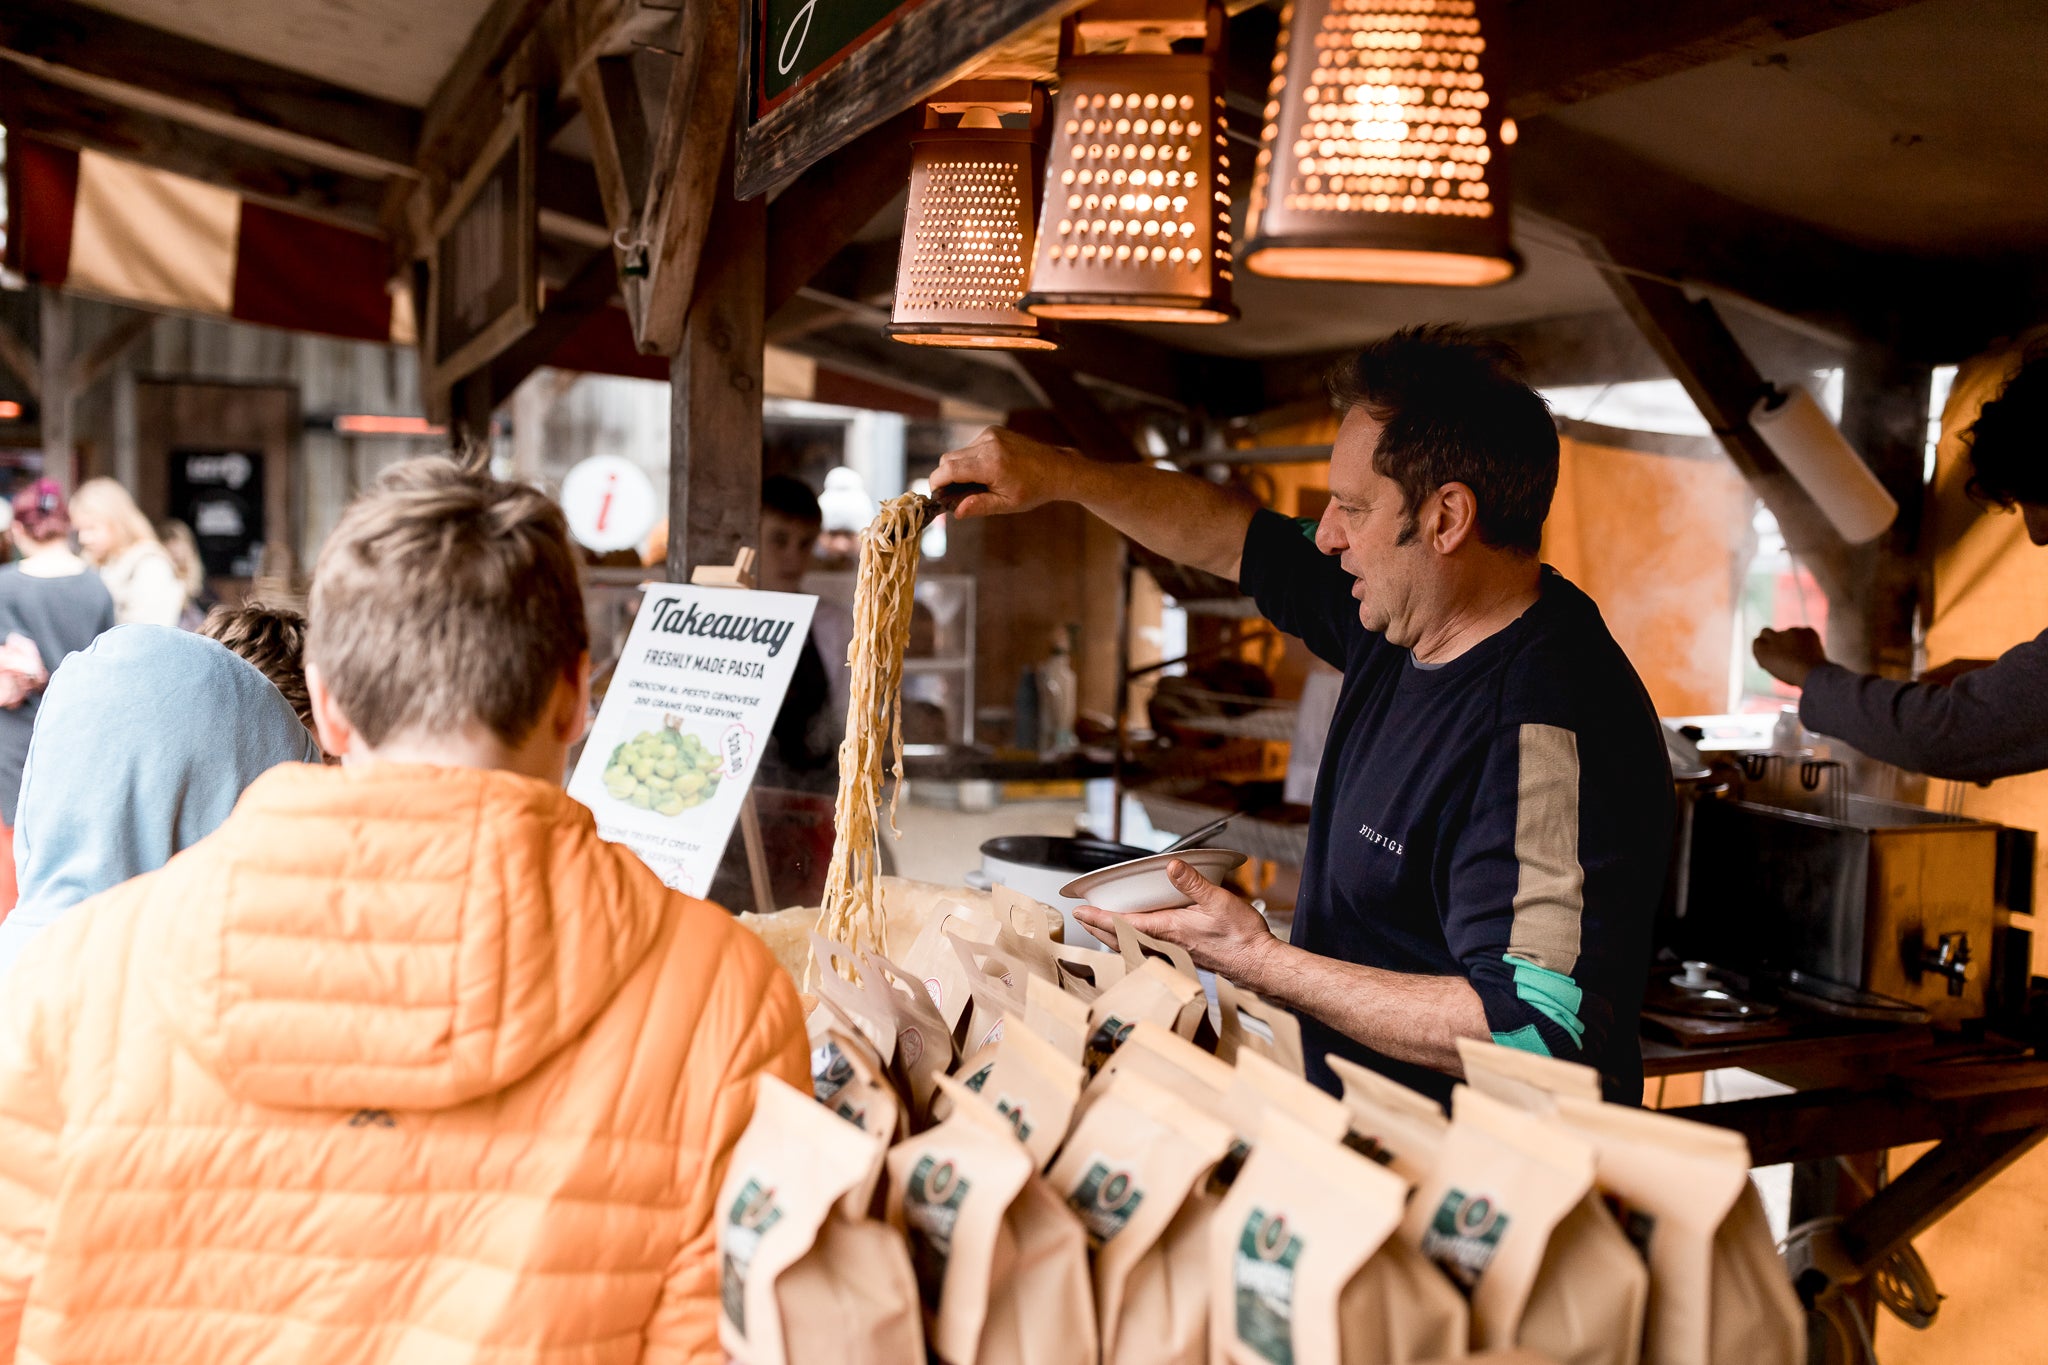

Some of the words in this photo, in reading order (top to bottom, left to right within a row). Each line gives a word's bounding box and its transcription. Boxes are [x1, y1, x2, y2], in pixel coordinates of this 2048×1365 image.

[651, 597, 795, 658] Takeaway
[643, 648, 692, 673] FRESHLY
[693, 656, 727, 675] MADE
[726, 660, 766, 679] PASTA
[652, 698, 682, 711] GRAMS
[684, 703, 703, 714] FOR
[704, 706, 743, 721] SERVING
[682, 687, 711, 700] PESTO
[712, 691, 761, 707] GENOVESE
